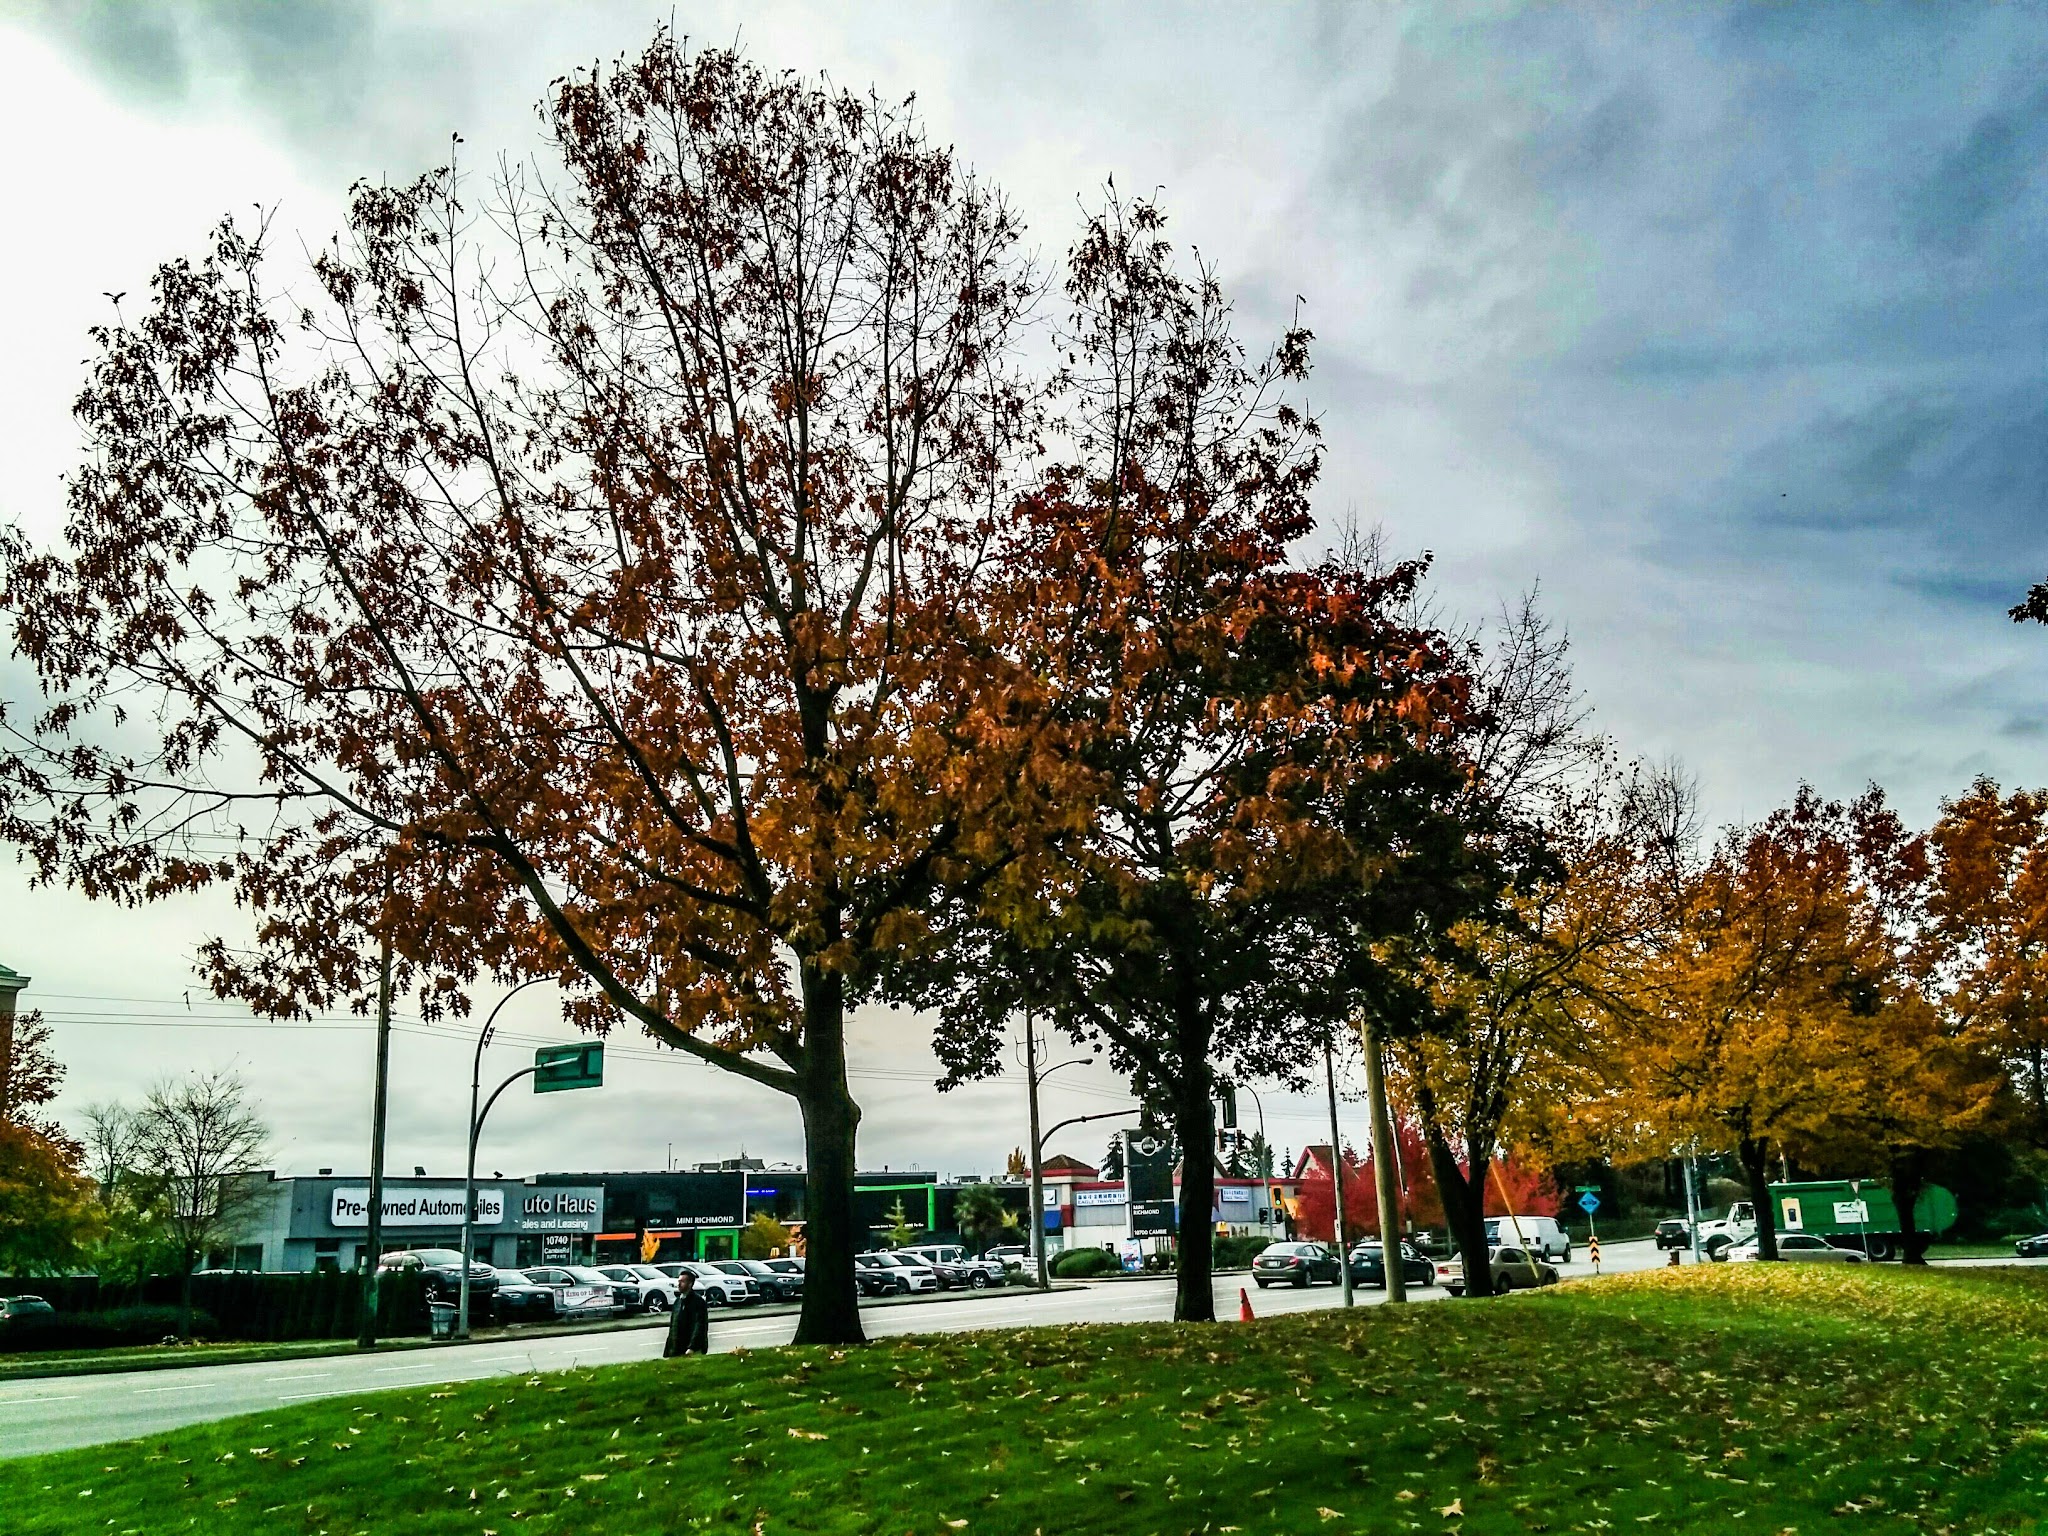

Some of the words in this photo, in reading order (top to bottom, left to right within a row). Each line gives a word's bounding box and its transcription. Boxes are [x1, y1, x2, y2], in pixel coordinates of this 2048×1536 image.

[336, 1198, 416, 1216] Pre-wned
[418, 1198, 500, 1216] Automiles
[556, 1194, 597, 1213] Haus
[540, 1218, 556, 1229] and
[557, 1218, 589, 1231] Leasing
[676, 1217, 693, 1225] MINI
[694, 1215, 735, 1224] RICHMOND
[546, 1236, 568, 1245] 10740
